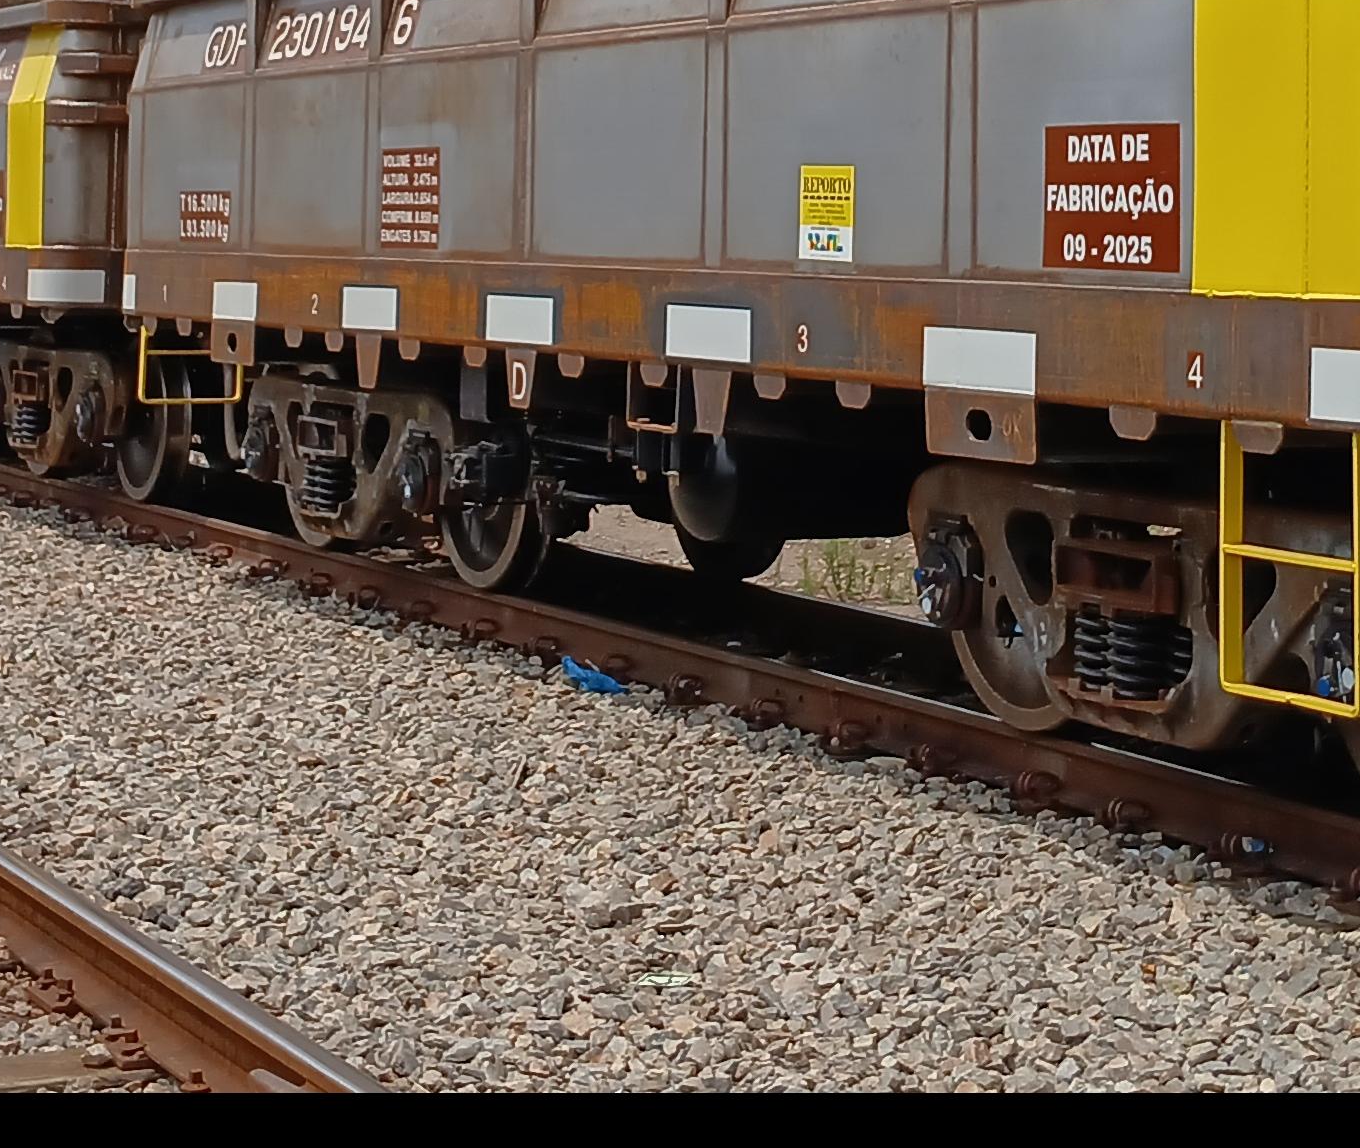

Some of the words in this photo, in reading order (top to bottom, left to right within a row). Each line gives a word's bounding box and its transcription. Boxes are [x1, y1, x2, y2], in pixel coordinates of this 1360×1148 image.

[268, 5, 371, 61] 230194
[1067, 134, 1116, 162] DATA
[1121, 133, 1149, 162] DE
[803, 176, 851, 194] REPORTO
[1047, 178, 1174, 220] FABRICAÇÃO
[180, 194, 187, 213] T
[188, 194, 217, 213] 16.500
[219, 194, 230, 217] kg
[180, 220, 186, 238] L
[218, 220, 229, 243] kg
[1063, 233, 1086, 262] 09
[1103, 234, 1153, 264] 2025
[311, 293, 320, 315] 2
[798, 326, 809, 353] 3
[511, 361, 526, 401] D
[1188, 355, 1203, 390] 4
